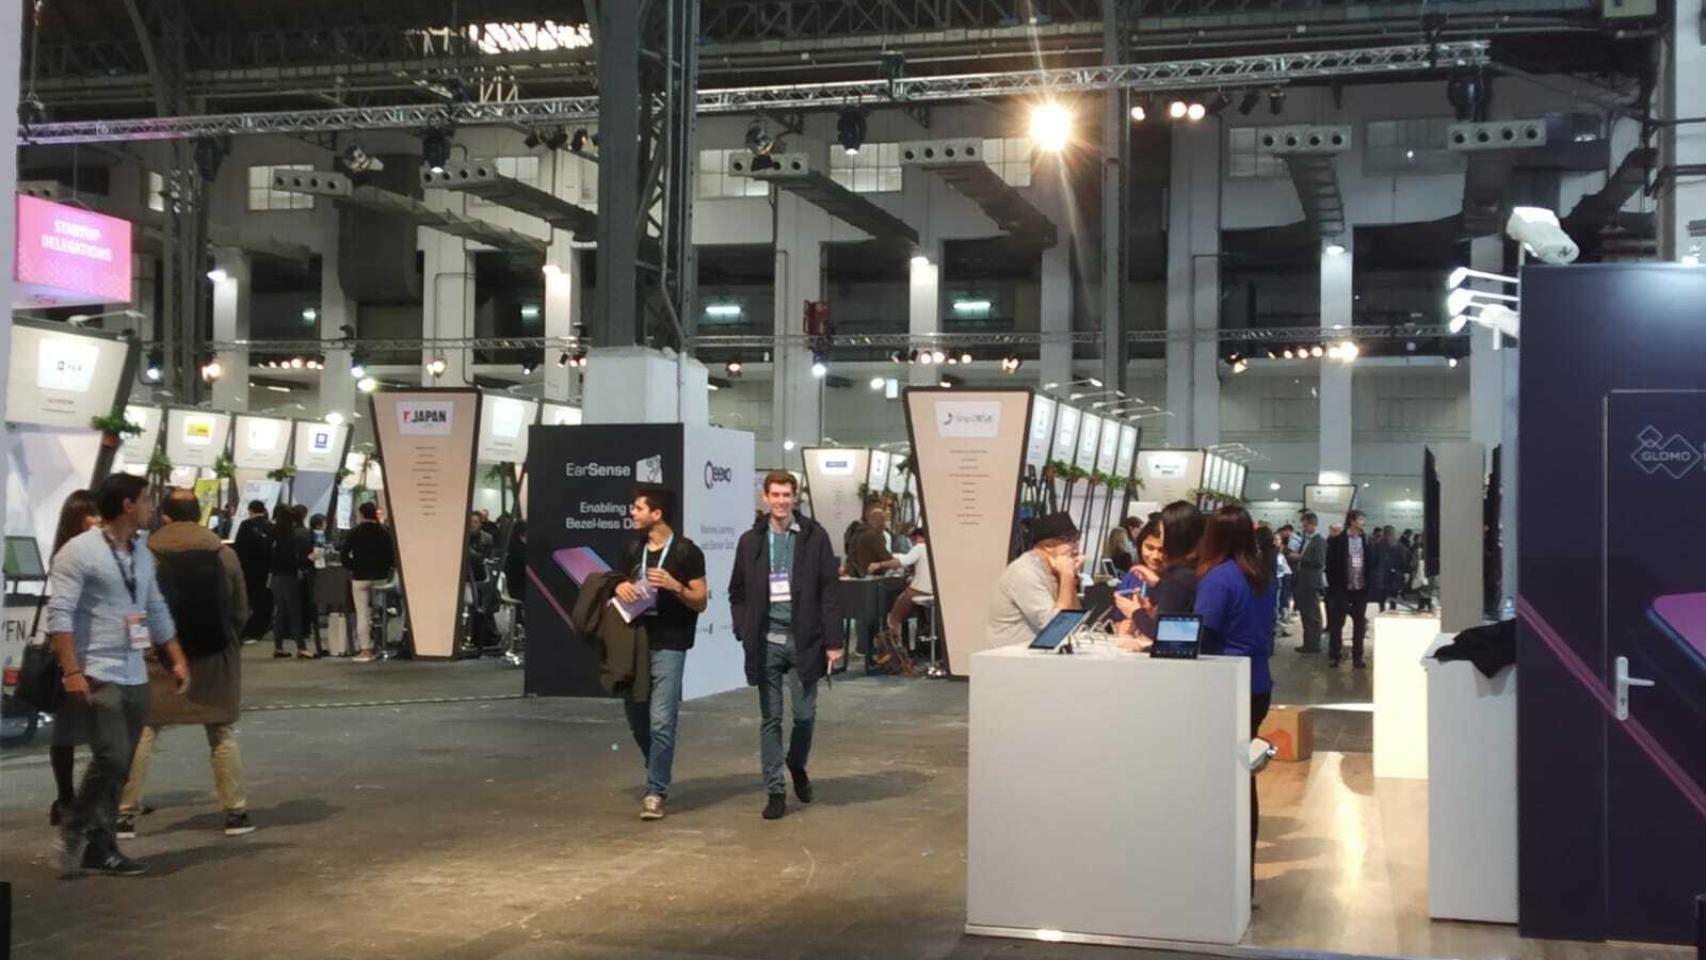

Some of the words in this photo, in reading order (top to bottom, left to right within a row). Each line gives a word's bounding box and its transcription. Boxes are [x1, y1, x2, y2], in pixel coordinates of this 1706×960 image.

[411, 410, 446, 423] JAPAN
[1642, 451, 1691, 461] GLOMO
[565, 462, 631, 477] EarSense
[580, 501, 627, 516] Enabling
